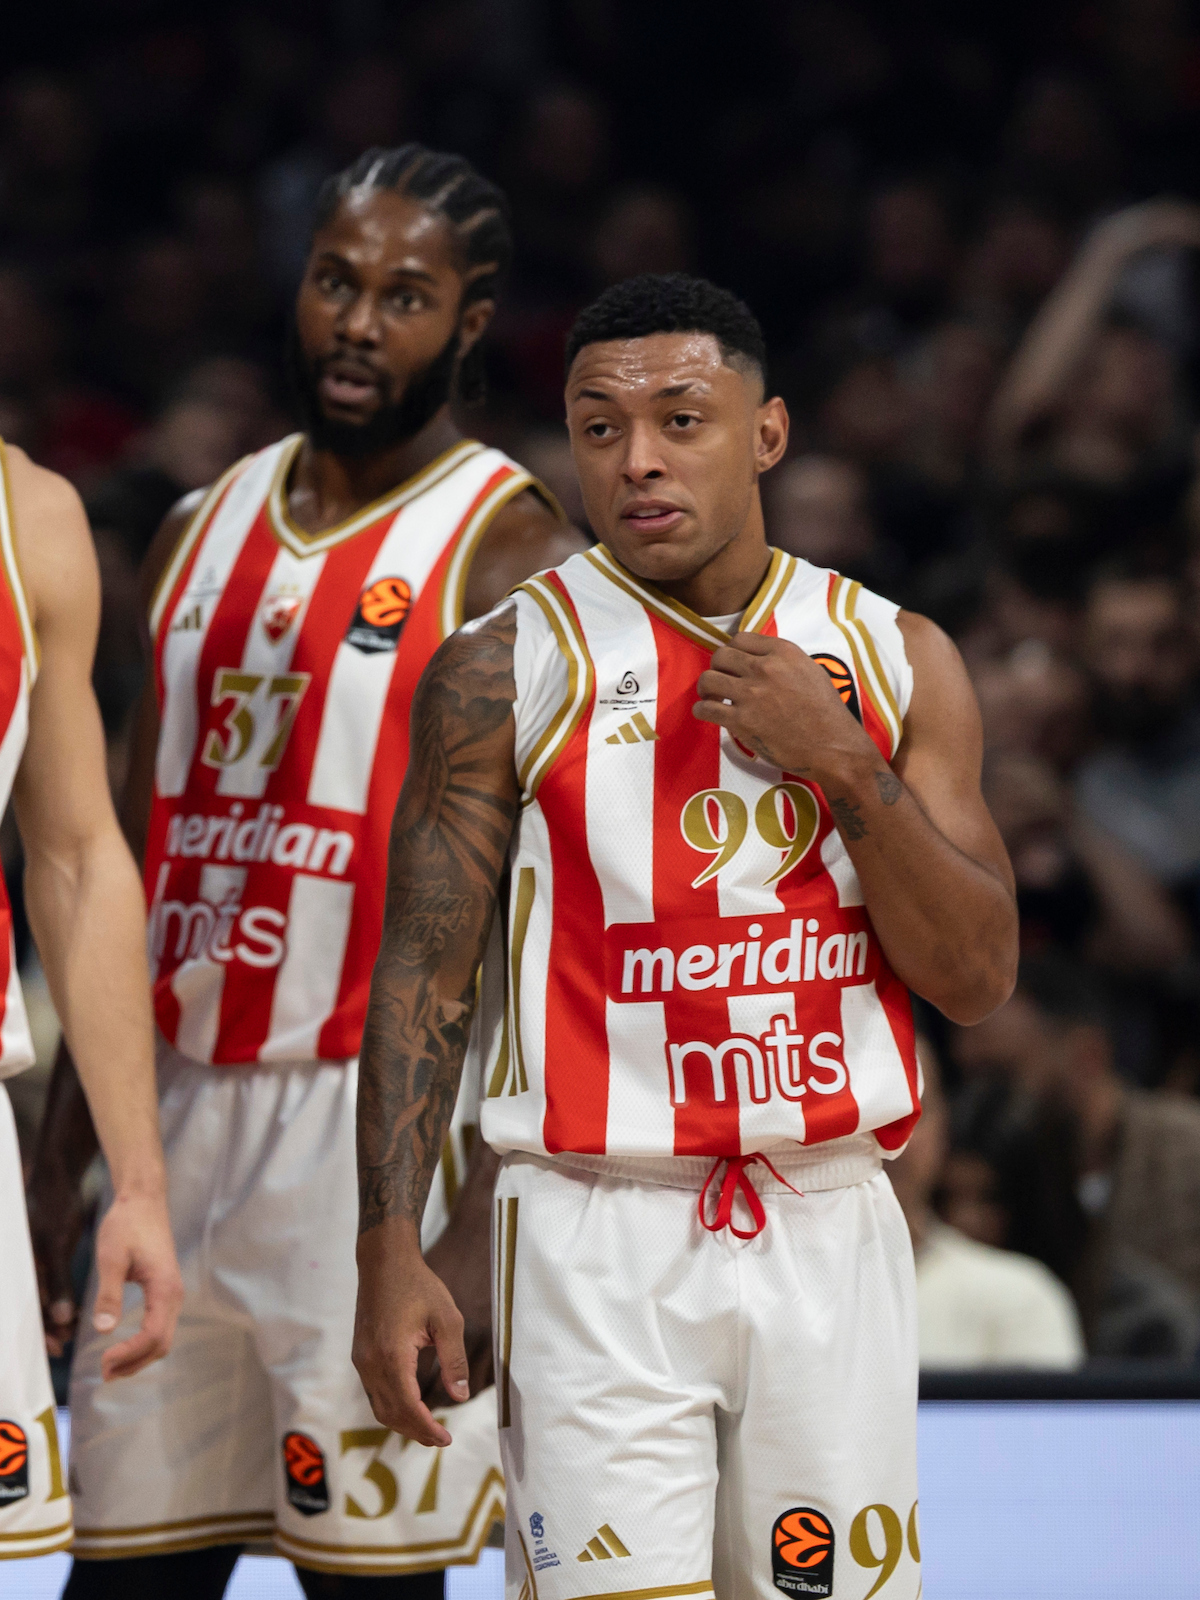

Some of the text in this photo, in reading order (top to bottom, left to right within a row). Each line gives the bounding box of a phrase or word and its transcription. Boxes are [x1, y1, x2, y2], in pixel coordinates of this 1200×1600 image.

[201, 665, 311, 770] 37
[680, 780, 821, 890] 99
[621, 917, 869, 994] meridian
[669, 1018, 848, 1104] mts
[796, 1582, 829, 1595] dhabi
